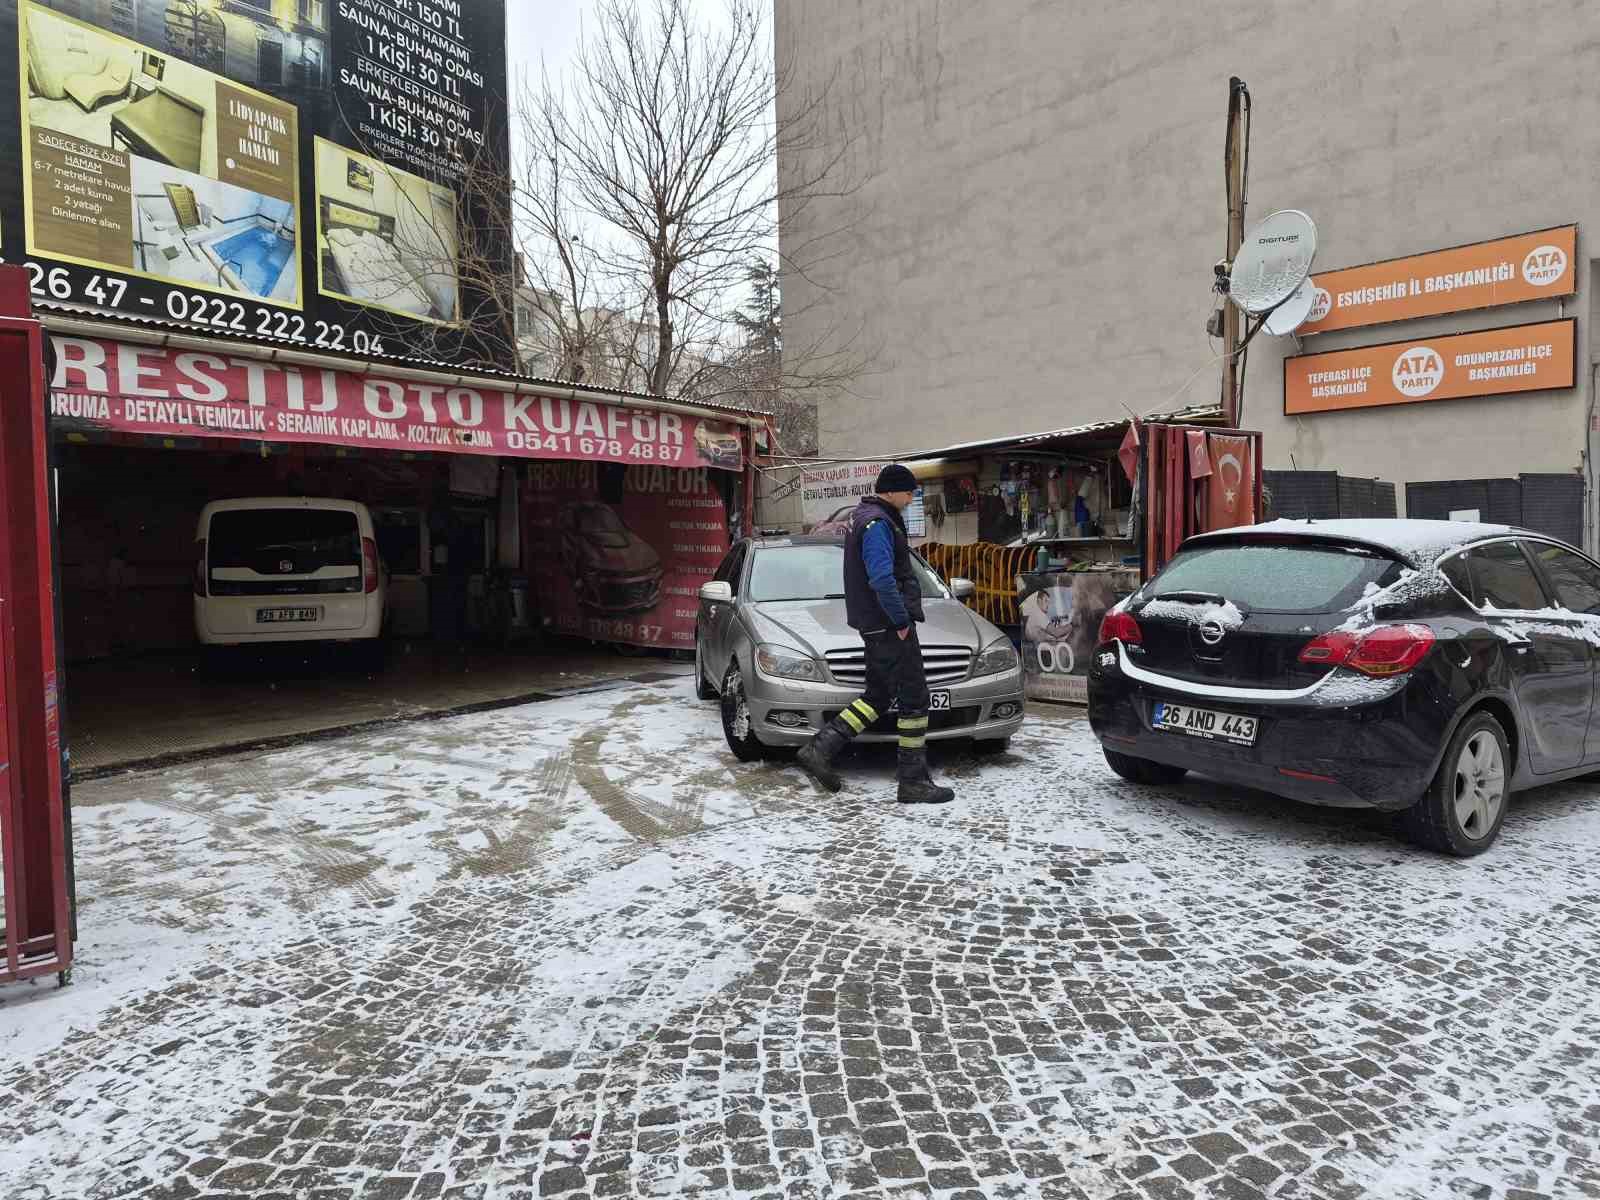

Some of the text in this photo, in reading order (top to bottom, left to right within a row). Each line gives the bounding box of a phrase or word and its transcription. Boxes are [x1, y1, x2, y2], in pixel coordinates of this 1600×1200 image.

[417, 2, 442, 29] 150
[446, 16, 464, 40] TL
[339, 2, 483, 88] SAUNA-BUHAR ODASI
[422, 29, 470, 63] HAMAMI
[366, 36, 373, 53] 1
[419, 63, 438, 85] 30
[443, 74, 460, 96] TL
[357, 58, 470, 122] ERKEKLER HAMAMI
[340, 69, 484, 146] SAUNA-BUHAR ODASI
[359, 122, 405, 148] ERKEKLERE
[368, 102, 375, 120] 1
[421, 125, 439, 147] 30
[38, 132, 77, 151] SADECE
[239, 138, 279, 166] HAMAMI
[34, 160, 52, 172] 6-7
[54, 167, 102, 185] metrekare
[64, 154, 102, 172] HAMAM
[55, 179, 113, 202] 2 adet kurna
[64, 195, 71, 205] 2
[52, 206, 97, 224] Dinlenme
[1526, 251, 1562, 270] ATA
[1337, 280, 1406, 307] ESKİŞEHİR
[1425, 261, 1515, 292] BAŞKANLIĞI
[84, 274, 128, 307] 47
[166, 290, 246, 330] 0222
[256, 309, 305, 341] 222
[314, 320, 345, 351] 22
[353, 330, 384, 355] 04
[1397, 355, 1439, 376] ATA
[125, 397, 192, 427] DETAYLI
[196, 403, 265, 431] TEMİZLİK
[277, 411, 338, 436] SERAMİK
[341, 417, 399, 441] KAPLAMA
[363, 379, 483, 427] OTO
[507, 430, 683, 461] 0541 678 48 87
[928, 693, 948, 709] 62
[1163, 705, 1181, 725] 26
[1185, 709, 1215, 731] AND
[1222, 716, 1254, 738] 443
